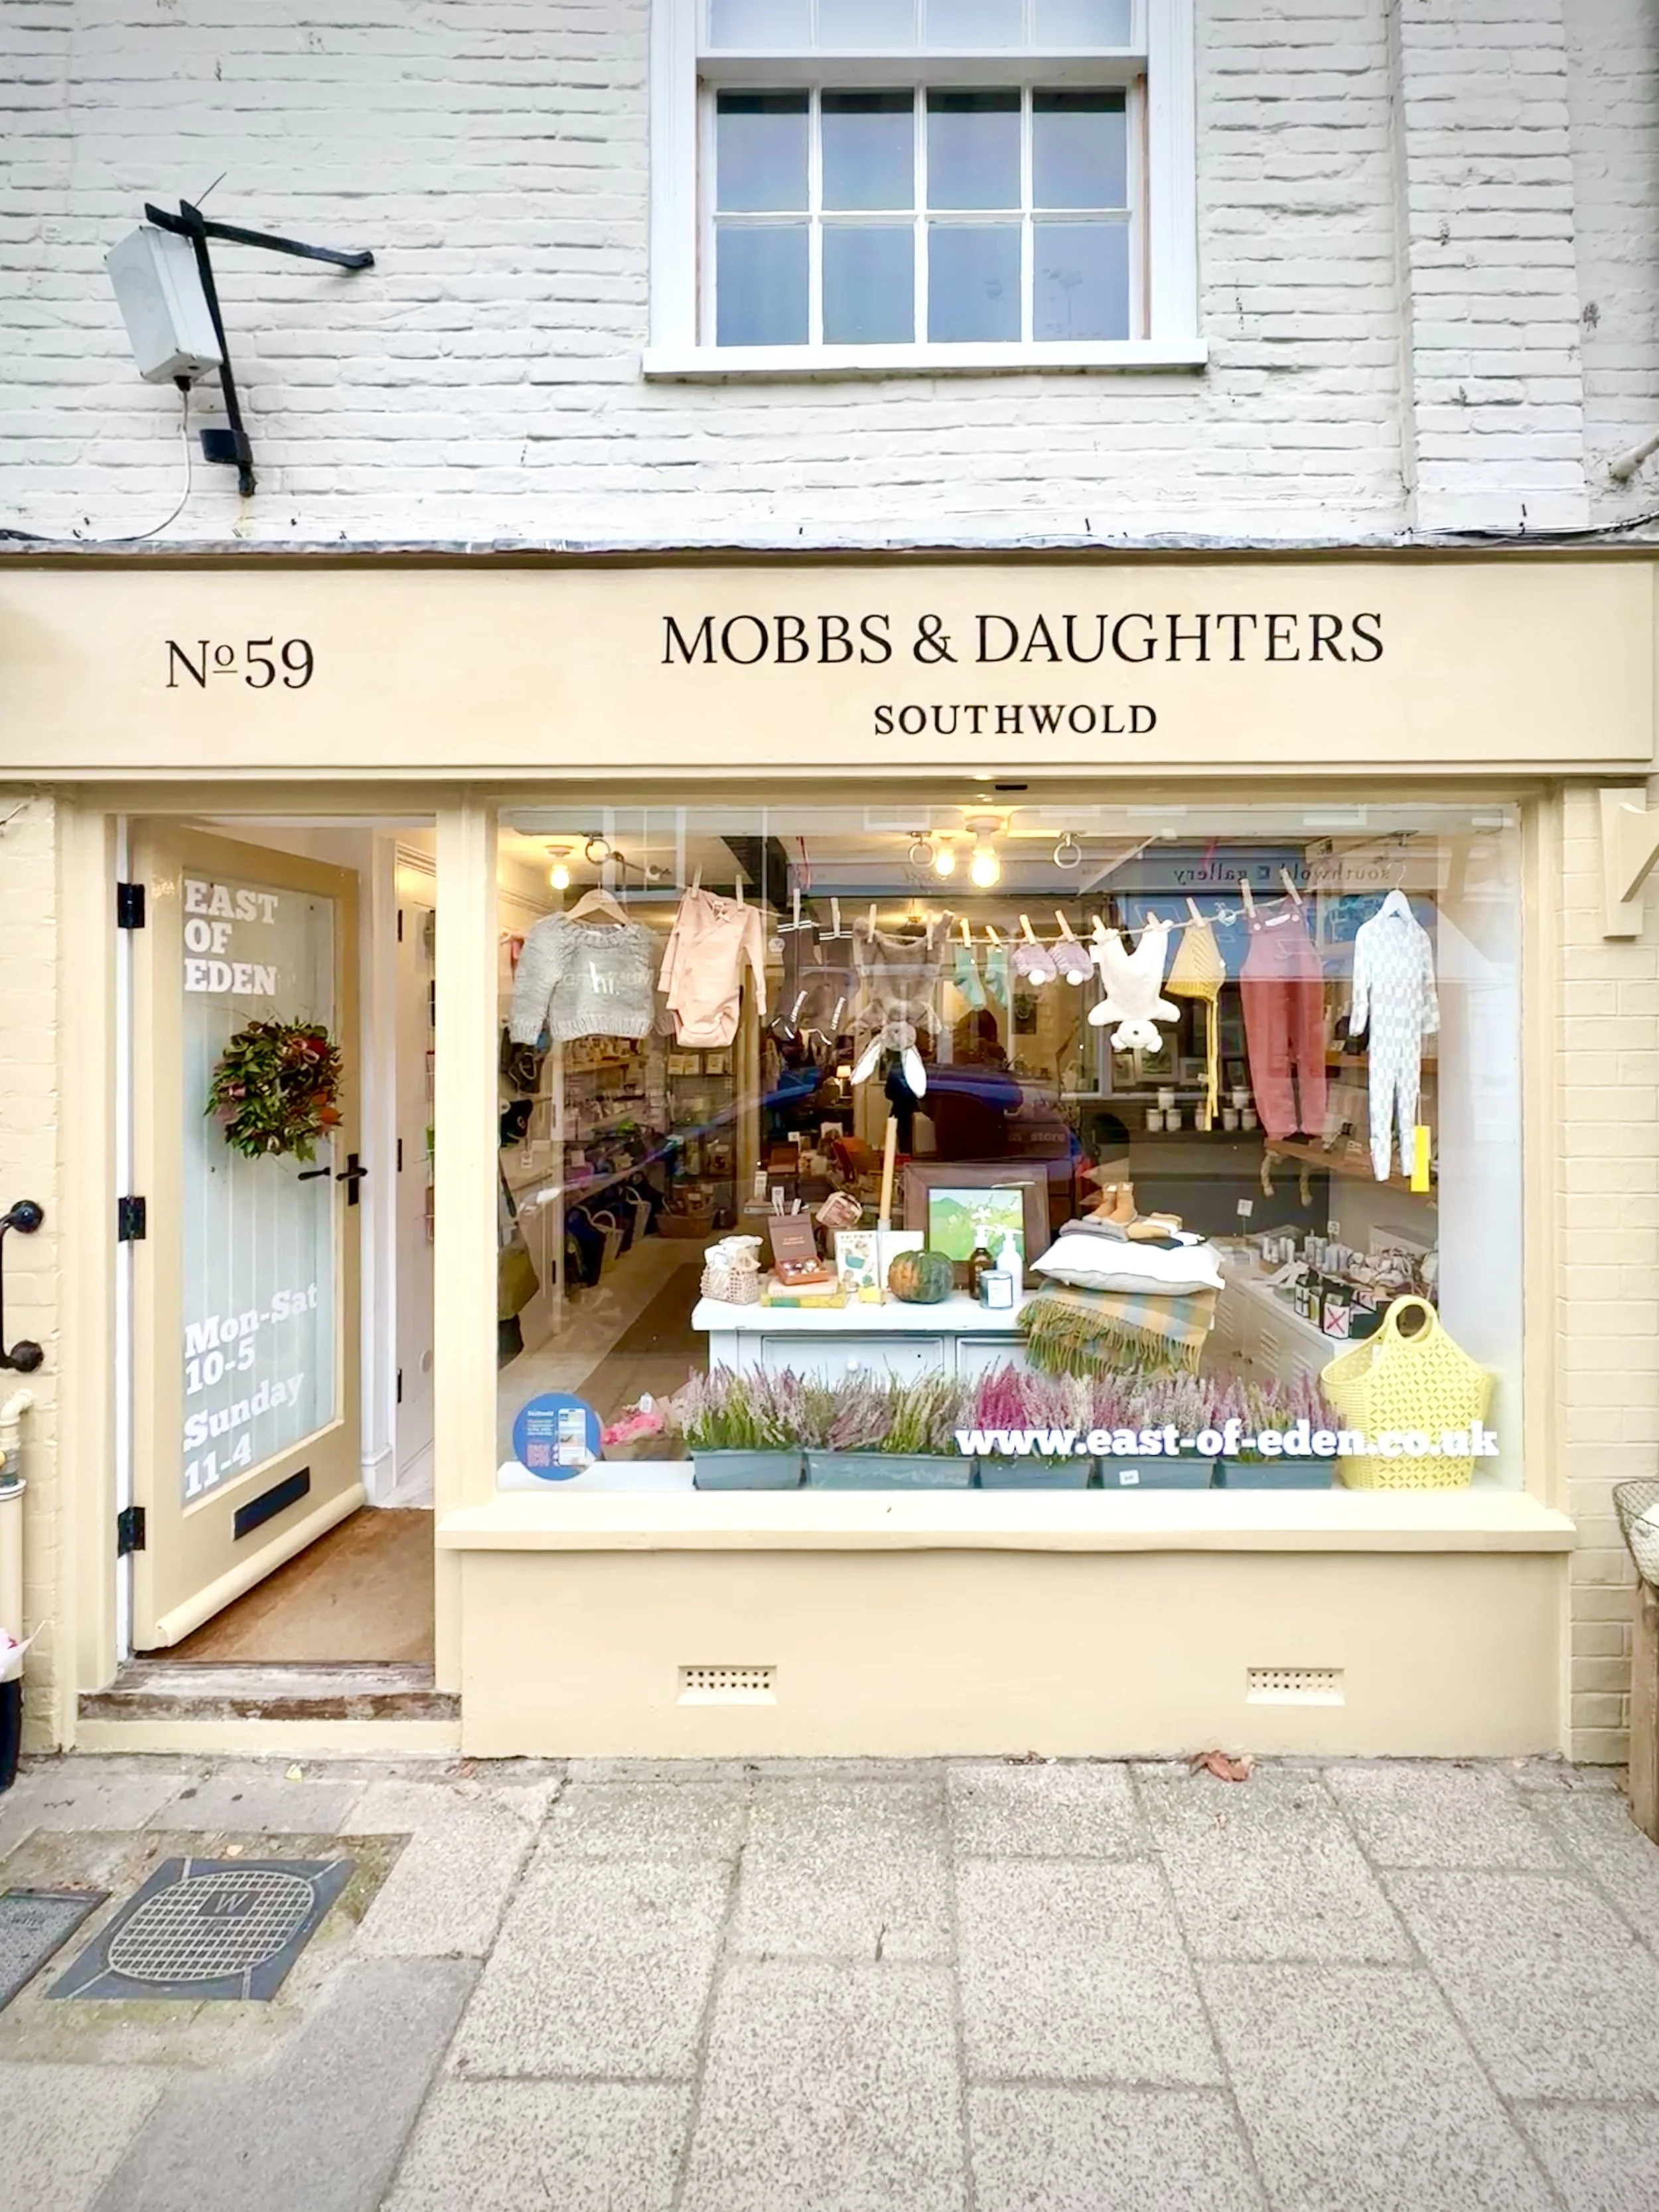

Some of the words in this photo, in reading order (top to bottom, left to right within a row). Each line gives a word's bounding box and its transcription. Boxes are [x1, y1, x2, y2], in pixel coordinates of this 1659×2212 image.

[662, 613, 892, 665] MOBBS
[913, 613, 958, 664] &
[975, 612, 1384, 664] DAUGHTERS
[875, 704, 1157, 735] SOUTHWOLD
[184, 879, 278, 924] EAST
[184, 918, 232, 954] OF
[184, 958, 277, 996] EDEN
[184, 1282, 317, 1359] Mon-Sat
[185, 1335, 256, 1396] 10-5
[183, 1372, 305, 1453] Sunday
[954, 1419, 1500, 1457] www.east-of-eden.co.uk
[184, 1432, 252, 1499] 11-4
